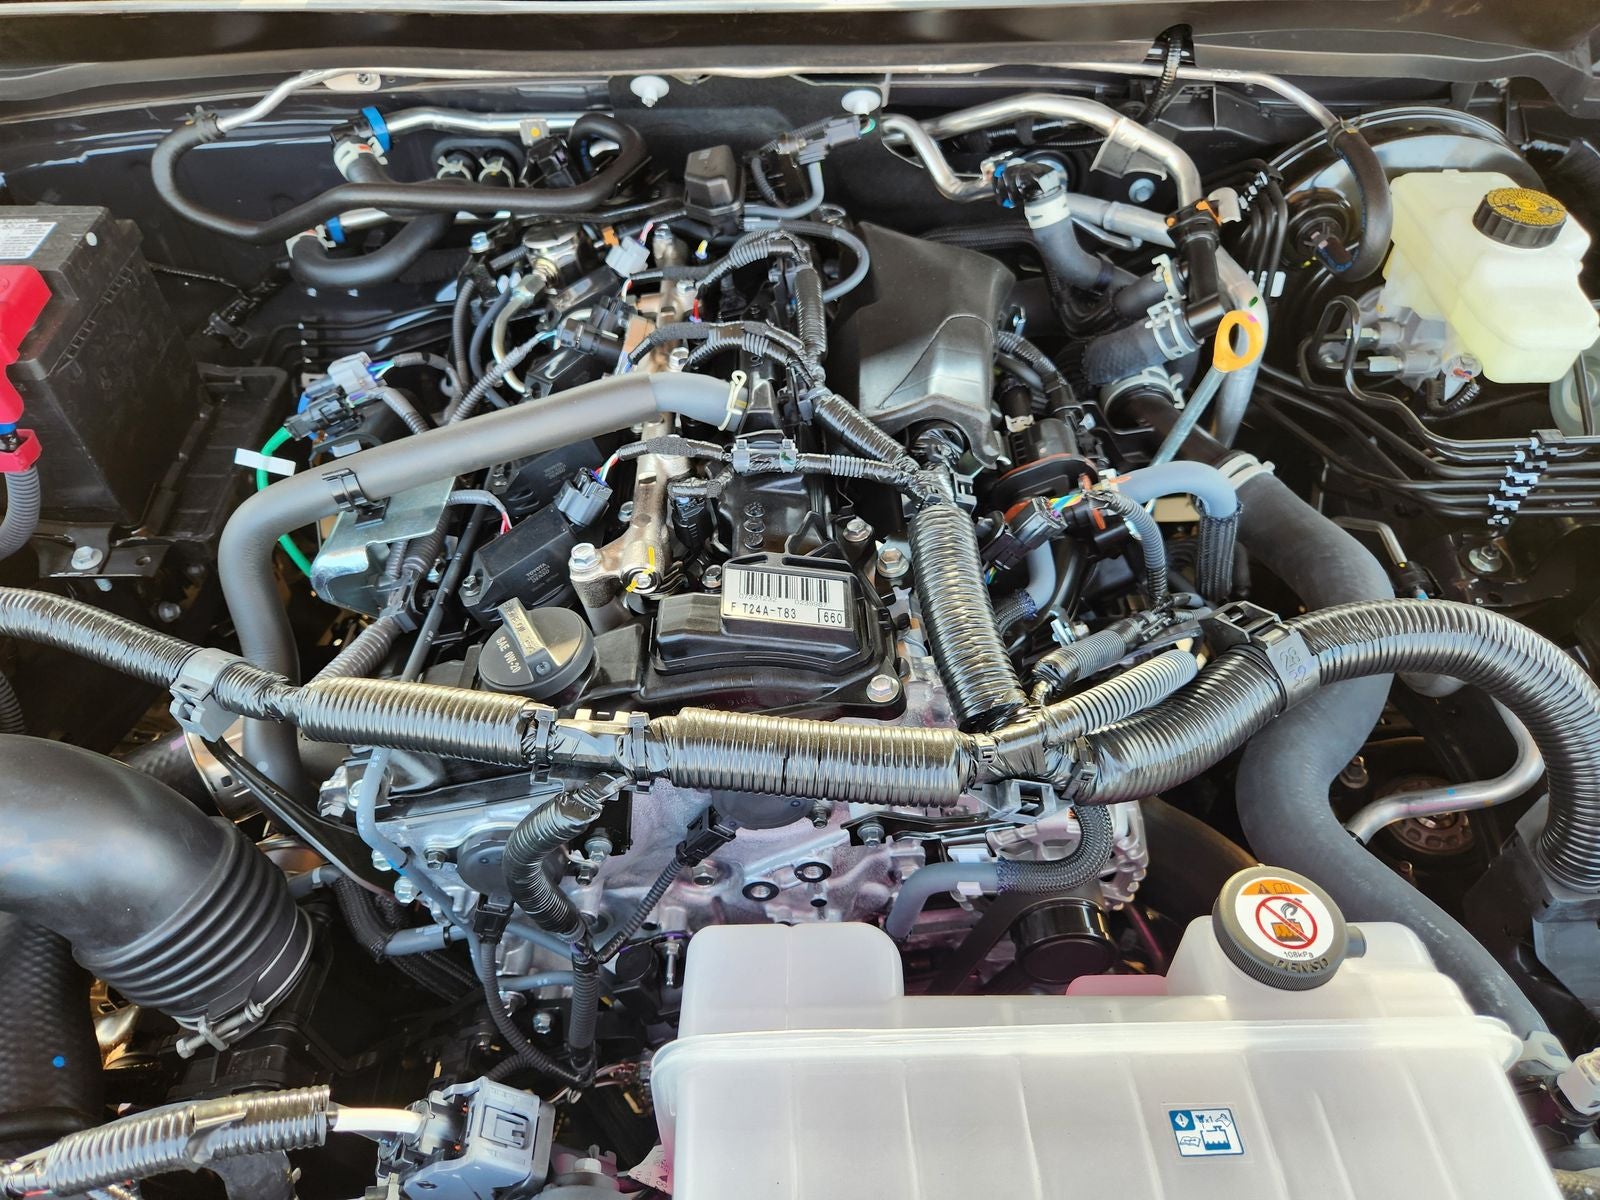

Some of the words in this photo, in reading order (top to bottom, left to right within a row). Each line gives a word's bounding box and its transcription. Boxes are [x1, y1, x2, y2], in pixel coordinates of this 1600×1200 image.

[823, 612, 843, 624] 660
[496, 636, 510, 652] SAE
[503, 650, 522, 674] 0W-20
[1283, 951, 1314, 960] 108kPa
[1273, 957, 1329, 974] DENSO
